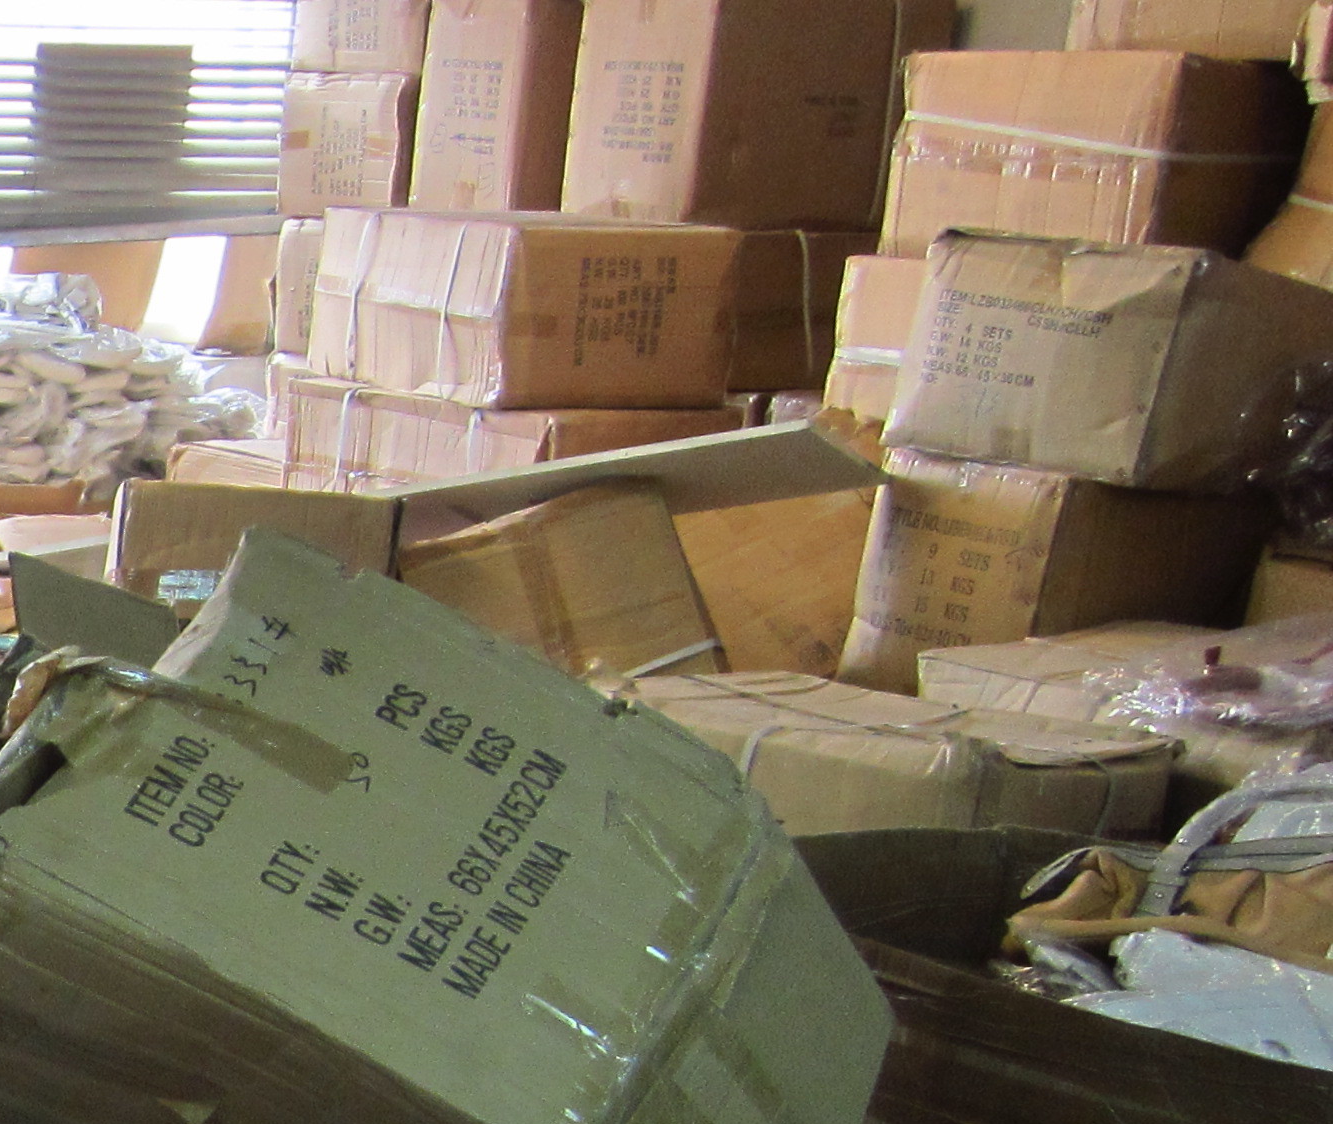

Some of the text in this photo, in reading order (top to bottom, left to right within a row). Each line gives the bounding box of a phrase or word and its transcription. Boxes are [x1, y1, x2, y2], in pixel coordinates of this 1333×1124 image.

[973, 355, 999, 368] KGS
[976, 340, 1002, 354] KGS
[983, 326, 1013, 341] SETS
[949, 575, 975, 595] KGS
[959, 549, 991, 572] SETS
[943, 602, 970, 622] KGS
[123, 764, 188, 827] ITEM
[168, 771, 244, 847] COLOR:
[259, 684, 427, 895] QTY: PCS
[304, 705, 472, 921] N.W: KGS
[353, 726, 516, 945] G.W: KGS
[396, 748, 567, 973] MEAS: 66X45X52CM
[442, 840, 572, 999] MADE IN CHINA
